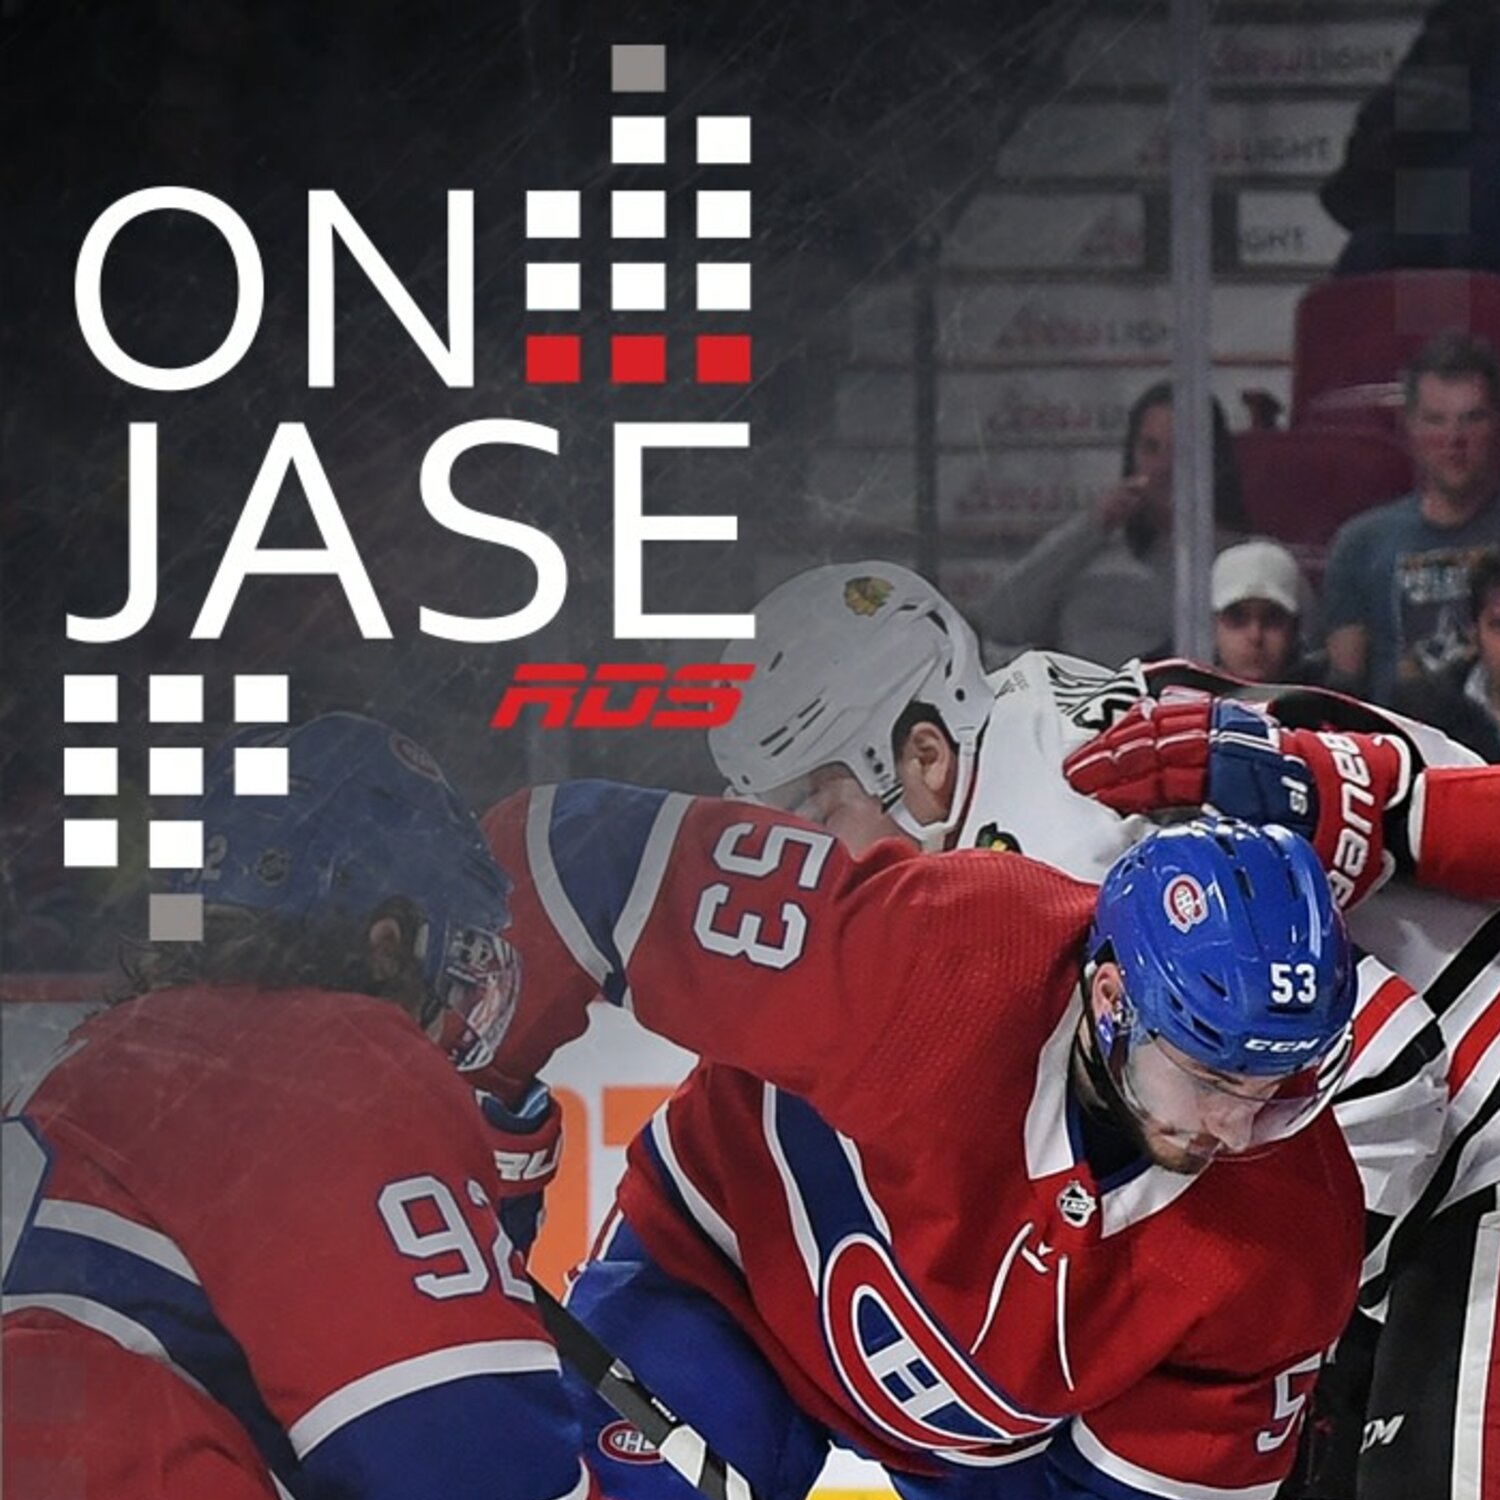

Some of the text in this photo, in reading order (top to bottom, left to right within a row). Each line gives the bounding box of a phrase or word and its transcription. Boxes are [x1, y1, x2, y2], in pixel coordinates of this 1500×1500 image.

[694, 822, 835, 970] 53
[1270, 963, 1317, 1004] 53
[1244, 1037, 1320, 1051] CCM
